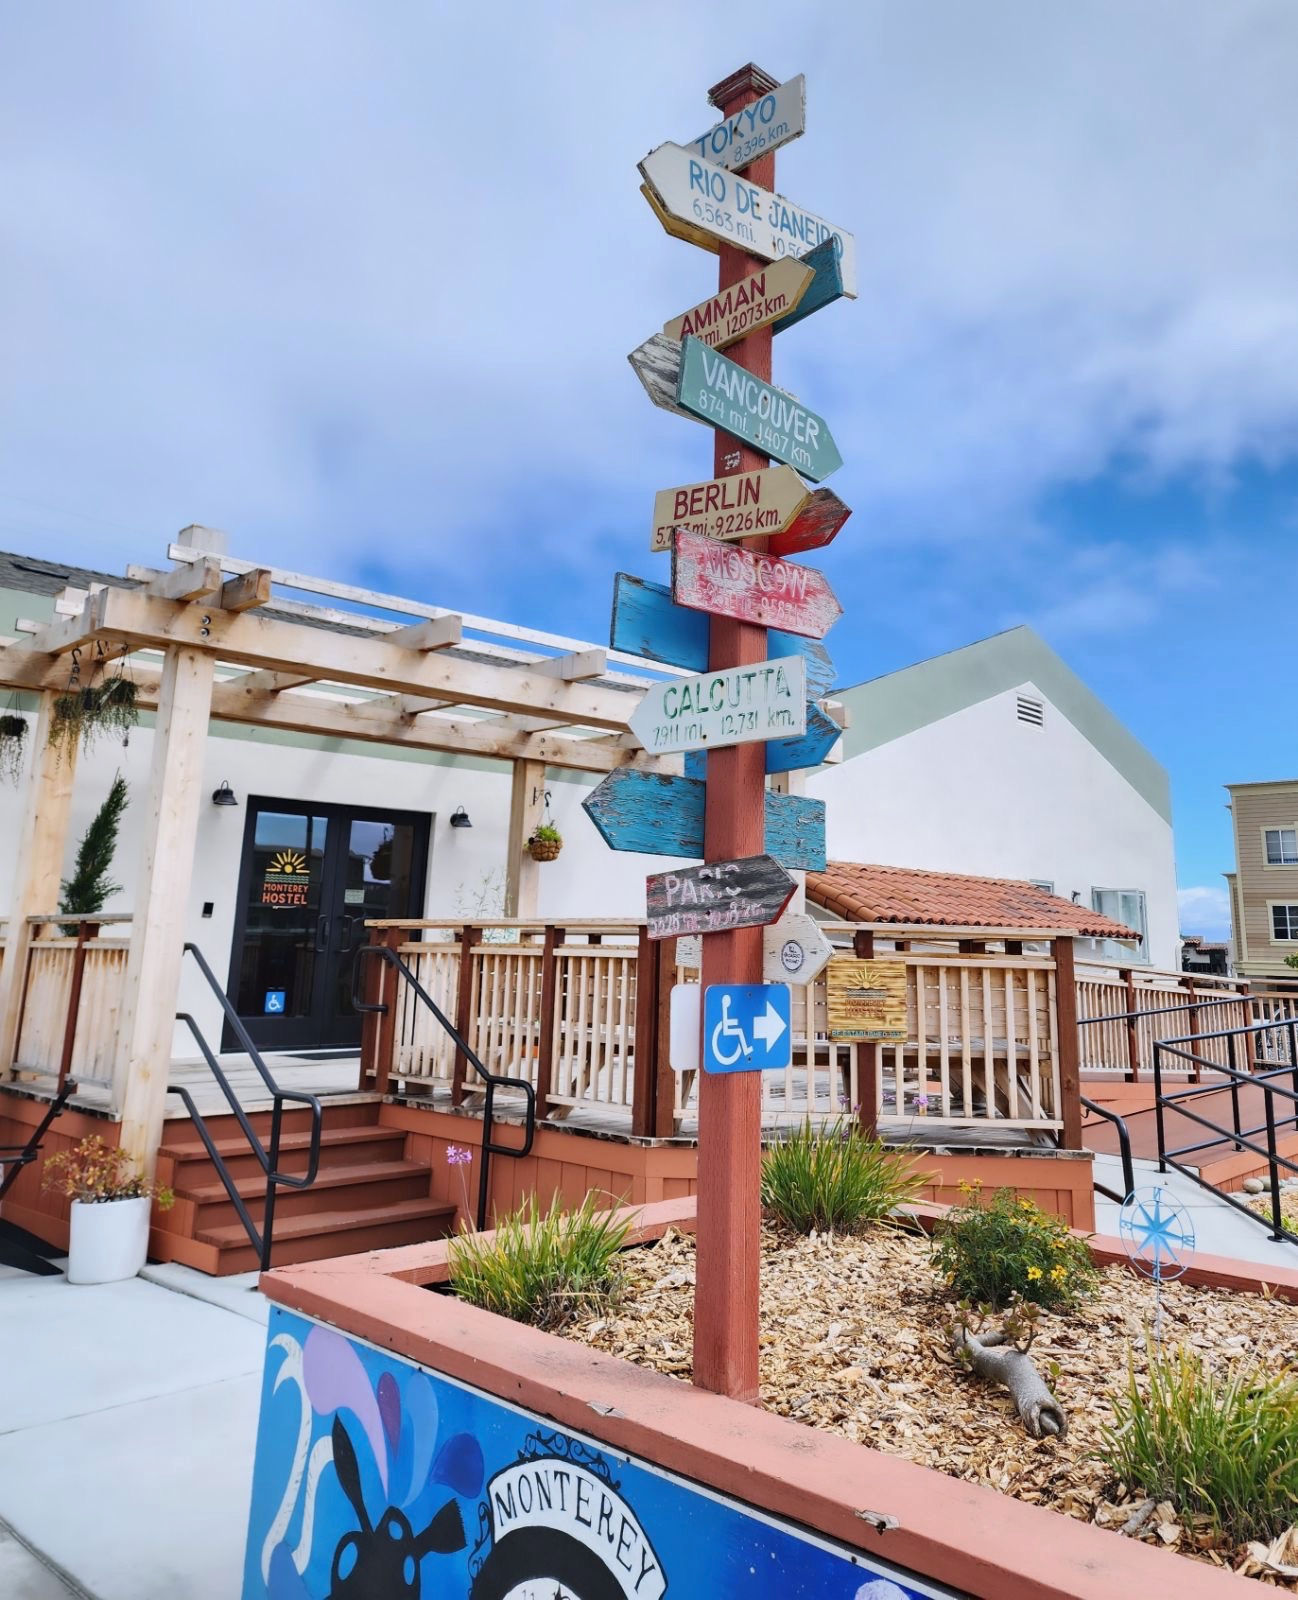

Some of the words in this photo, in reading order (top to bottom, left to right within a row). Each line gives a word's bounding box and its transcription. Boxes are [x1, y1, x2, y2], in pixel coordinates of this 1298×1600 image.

[695, 95, 776, 159] TOKYO
[735, 135, 766, 163] 8,396
[690, 160, 726, 202] RIO
[736, 181, 762, 221] DE
[693, 198, 733, 233] 6,563
[736, 221, 756, 243] mi.
[680, 272, 766, 341] AMMAN
[727, 302, 763, 336] 12,073
[765, 293, 789, 317] km.
[701, 351, 820, 450] VANCOUVER
[699, 389, 725, 419] 874
[730, 410, 748, 434] mi.
[791, 440, 815, 470] km.
[673, 475, 761, 520] BERLIN
[716, 511, 753, 538] 9,226
[755, 508, 781, 529] km.
[707, 547, 807, 599] MOSCOW
[663, 666, 791, 720] CALCUTTA
[721, 710, 758, 736] 12,731
[767, 706, 795, 728] km.
[262, 892, 308, 905] HOSTEL
[263, 883, 309, 893] MONTEREY
[494, 1470, 656, 1594] MONTEREY
